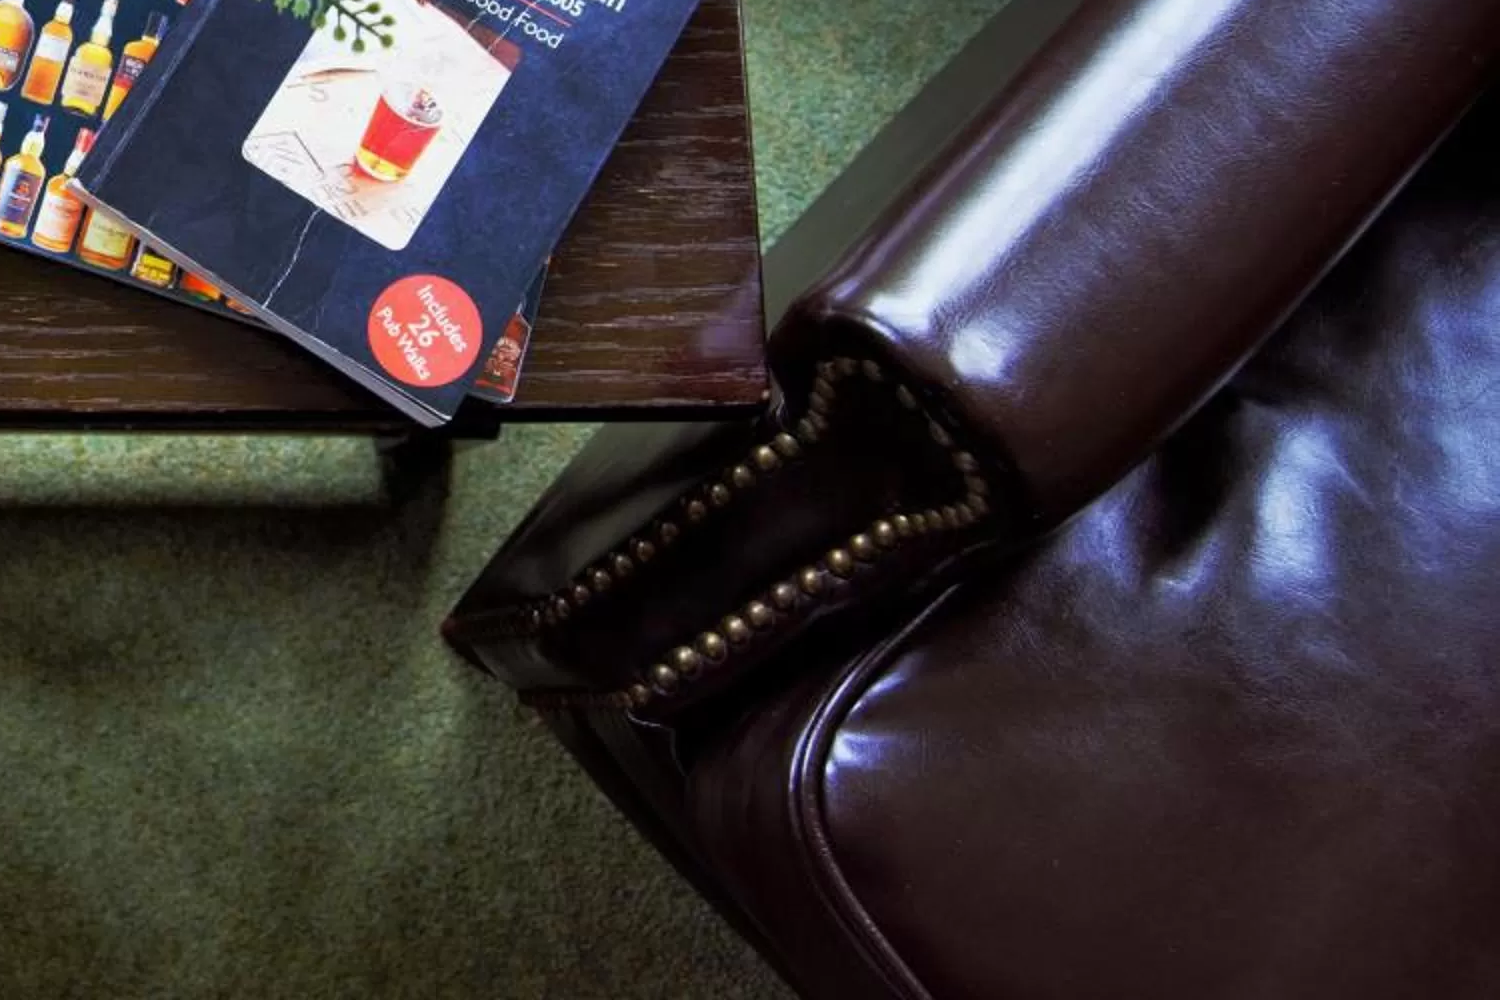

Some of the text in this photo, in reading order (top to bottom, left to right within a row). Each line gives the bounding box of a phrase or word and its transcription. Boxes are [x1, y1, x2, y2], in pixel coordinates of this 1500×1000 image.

[512, 10, 564, 48] Food
[377, 306, 401, 337] Pub
[407, 314, 440, 347] 26
[417, 284, 467, 353] Includes
